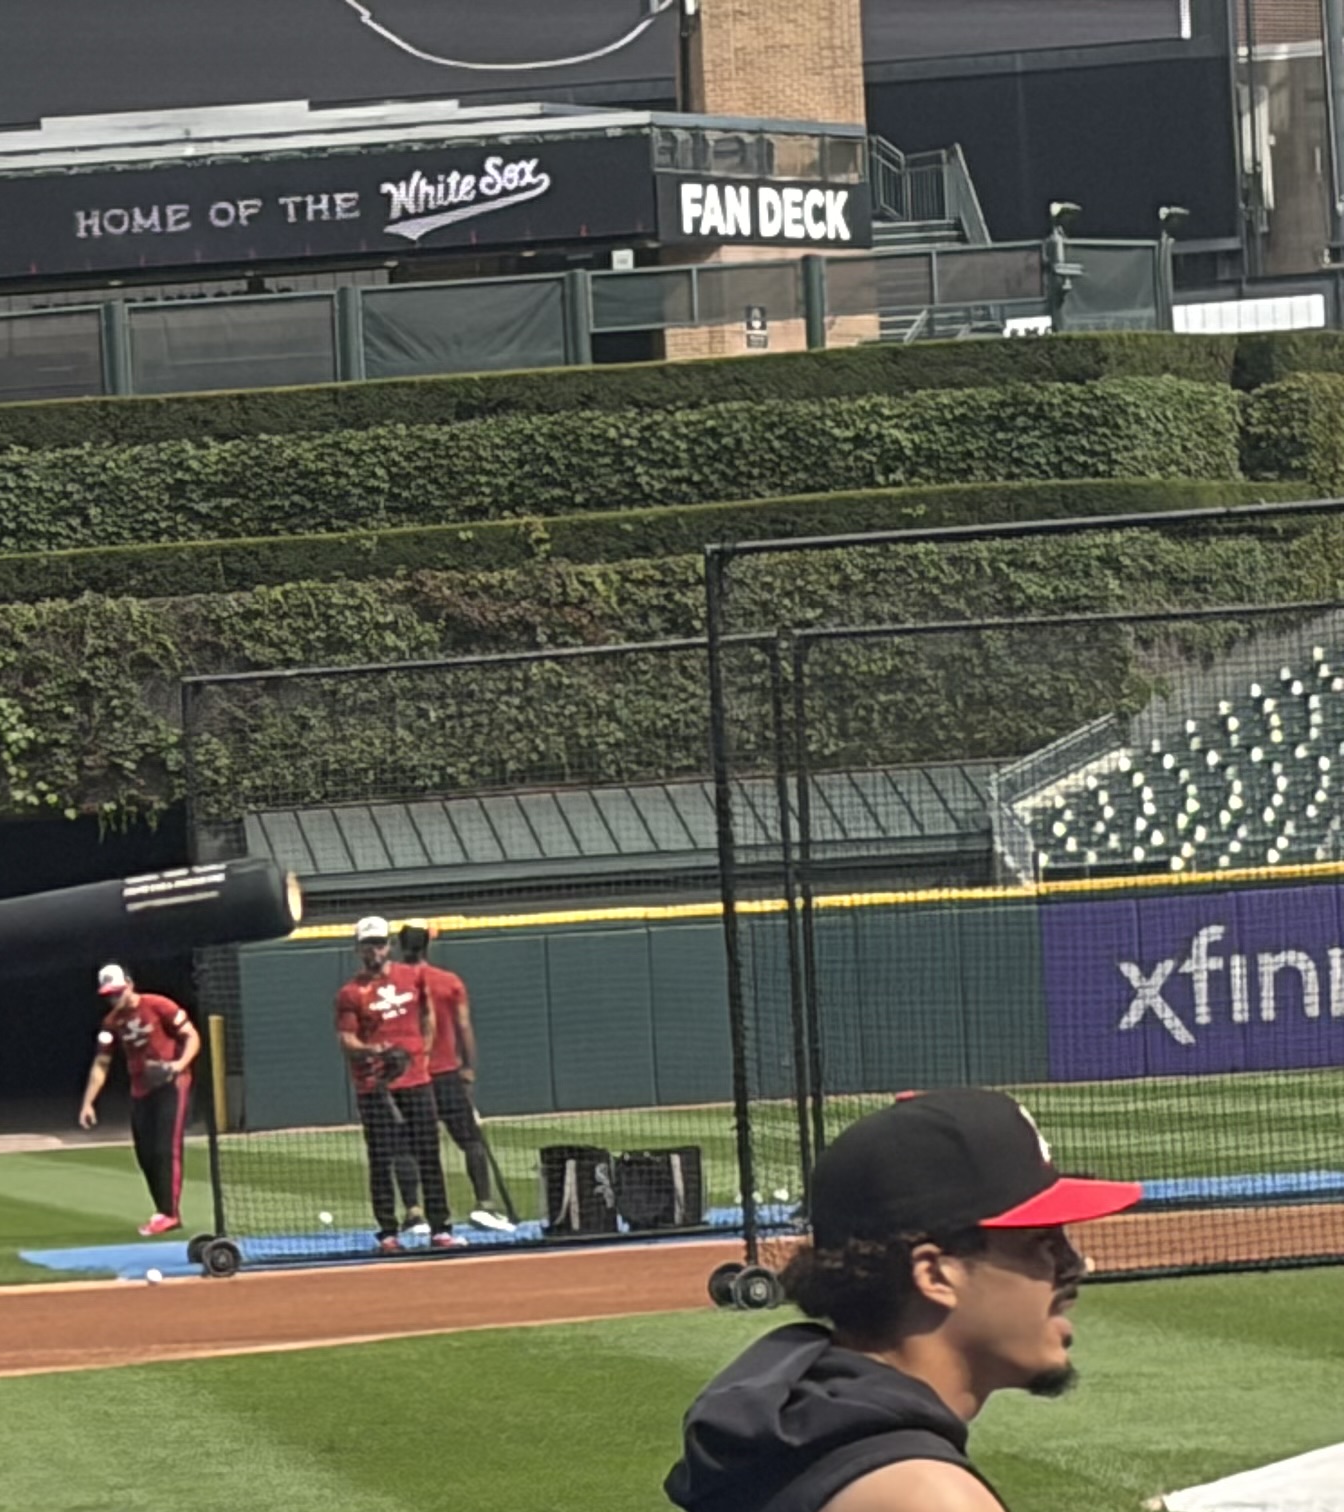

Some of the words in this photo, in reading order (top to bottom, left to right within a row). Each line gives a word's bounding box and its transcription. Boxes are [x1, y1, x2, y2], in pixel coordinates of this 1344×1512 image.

[75, 204, 192, 238] HOME
[209, 199, 262, 227] OF
[278, 192, 361, 222] THE
[380, 170, 477, 220] White
[479, 156, 544, 196] Sox
[680, 183, 750, 236] FAN
[758, 186, 851, 241] DECK
